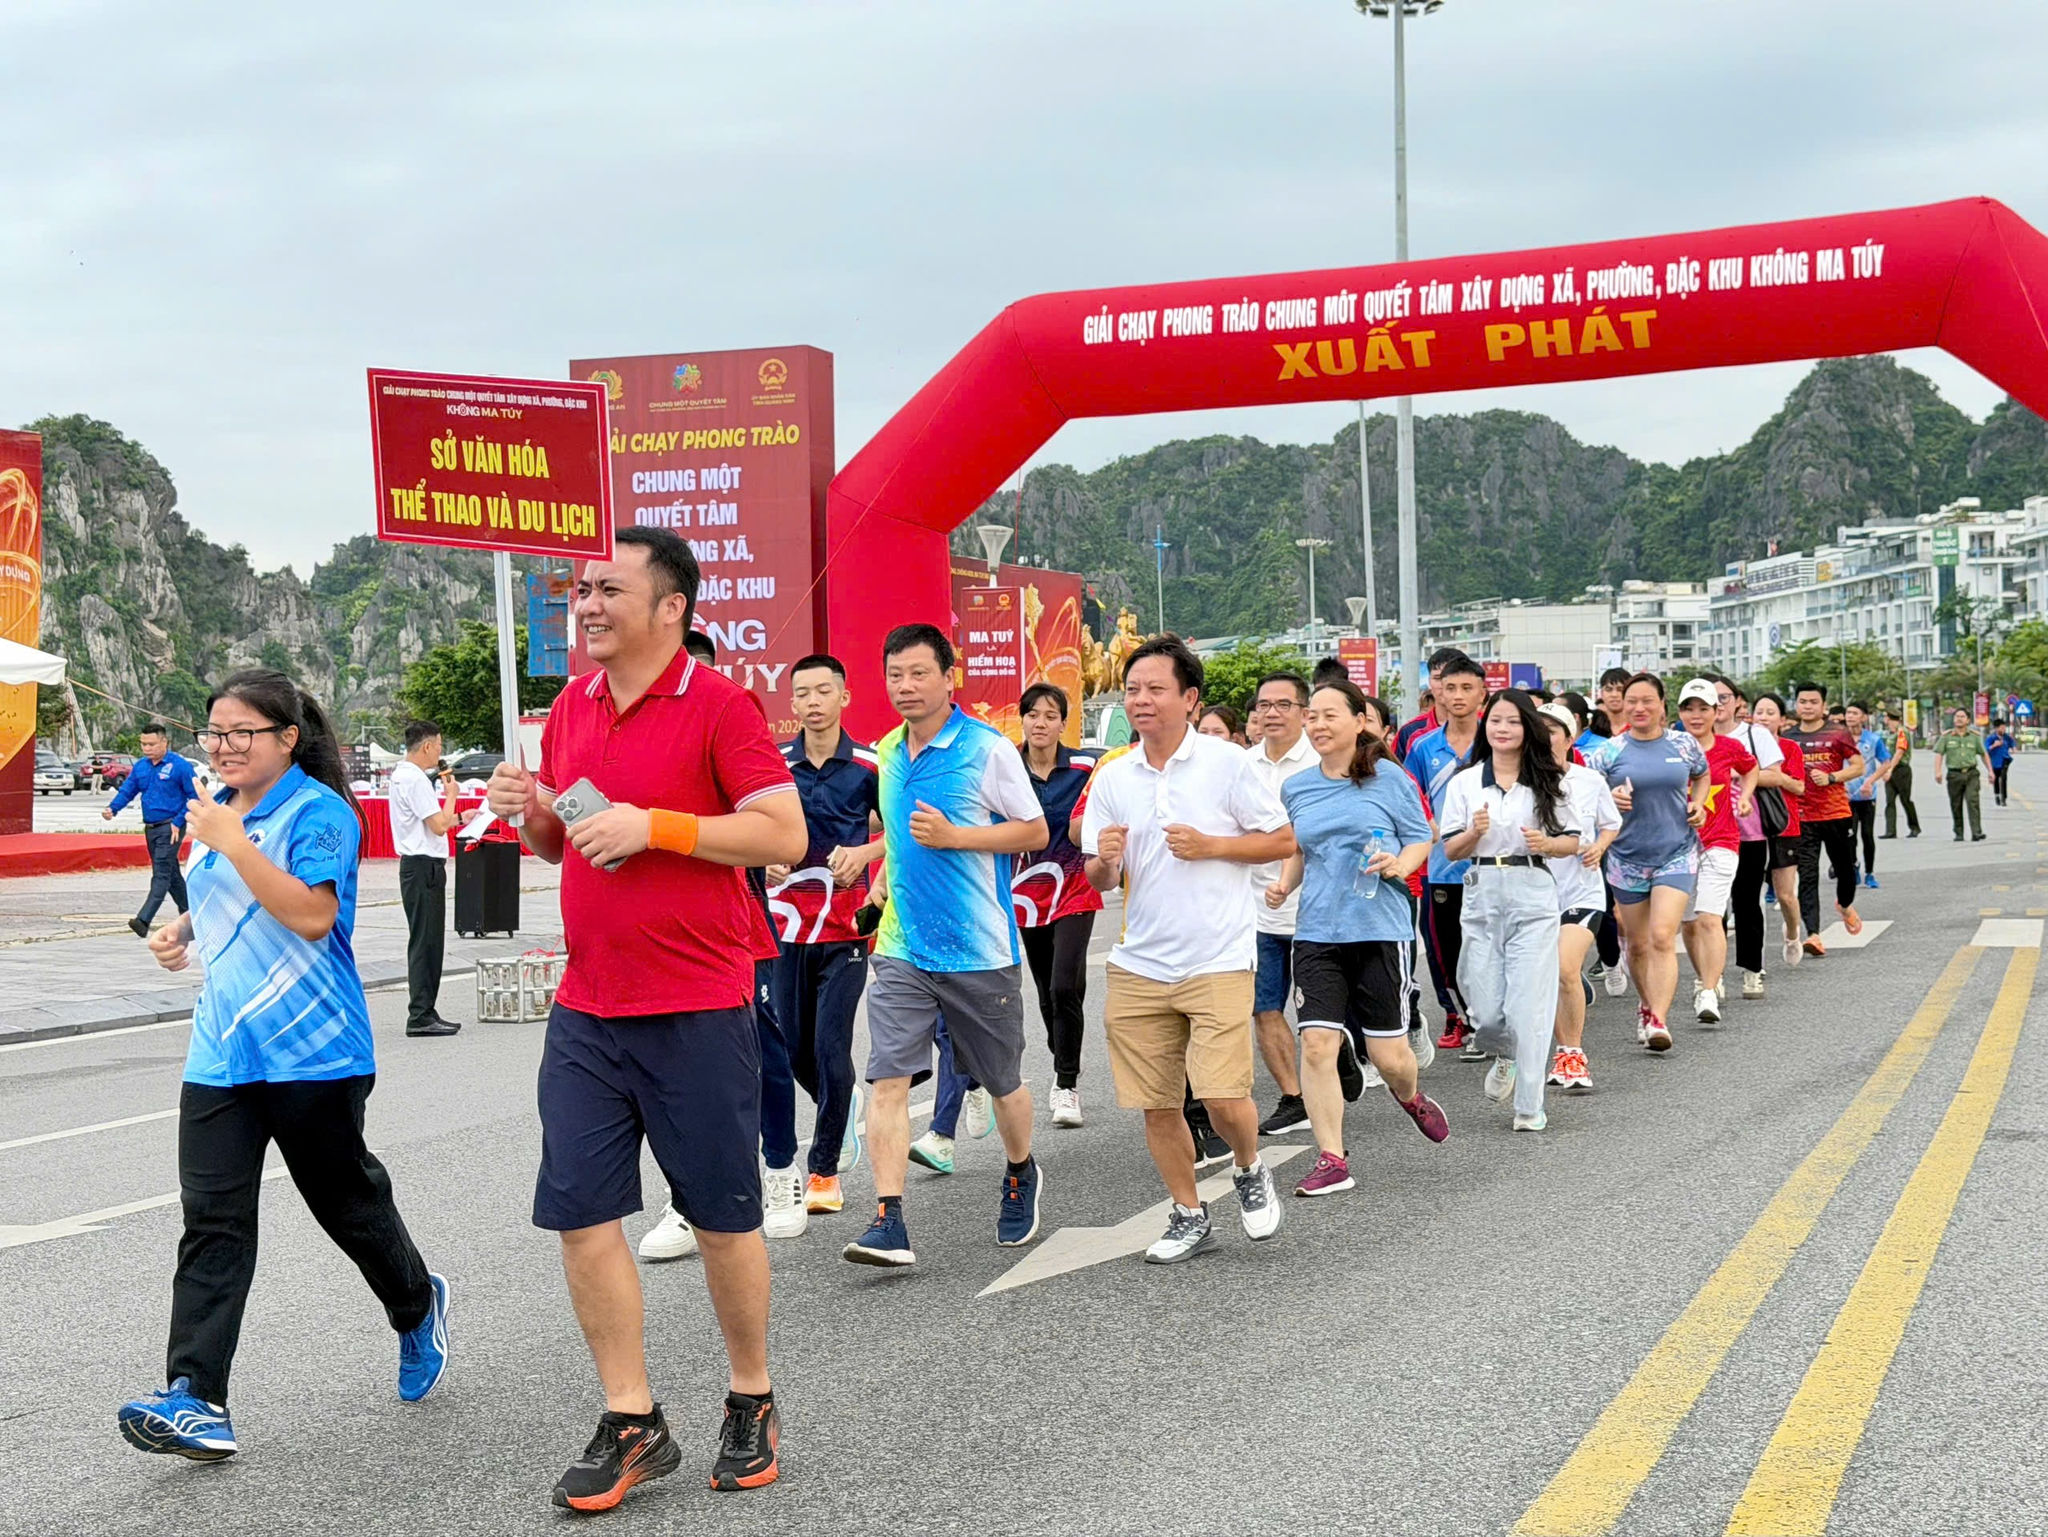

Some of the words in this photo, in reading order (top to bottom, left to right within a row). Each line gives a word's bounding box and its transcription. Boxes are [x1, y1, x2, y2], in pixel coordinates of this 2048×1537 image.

[1083, 305, 1113, 345] GIẢI
[1118, 310, 1157, 346] CHẠY
[1163, 305, 1212, 337] PHONG
[1222, 297, 1259, 333] TRÀO
[1265, 298, 1317, 331] CHUNG
[1363, 279, 1412, 325] QUYẾT
[1419, 279, 1453, 315] TÂM
[1460, 274, 1493, 312] XÂY
[1500, 272, 1545, 313] DỰNG
[1552, 267, 1582, 306] XÃ,
[1586, 260, 1661, 300] PHƯỜNG,
[1665, 256, 1700, 300] ĐẶC
[1708, 256, 1743, 291] KHU
[1750, 247, 1808, 287] KHÔNG
[1816, 248, 1845, 282] MA
[1851, 238, 1885, 278] TÚY
[1272, 320, 1436, 381] XUẤT
[1484, 305, 1658, 362] PHÁT
[446, 403, 480, 417] KHÔNG
[481, 407, 499, 418] MA
[500, 407, 522, 420] TÚY
[430, 428, 457, 470] SỞ
[462, 435, 503, 474] VĂN
[508, 438, 549, 478] HÓA
[630, 432, 679, 456] CHẠY
[682, 428, 747, 450] PHONG
[750, 419, 800, 447] TRÀO
[632, 469, 696, 494] CHUNG
[700, 462, 742, 494] MỘT
[390, 478, 427, 521] THỂ
[431, 491, 482, 526] THAO
[486, 491, 514, 529] VÀ
[518, 499, 545, 532] DU
[550, 502, 596, 542] LỊCH
[634, 498, 693, 528] QUYẾT
[696, 499, 738, 526] TÂM
[722, 534, 754, 563] XÃ,
[697, 575, 733, 605] ĐẶC
[737, 577, 775, 600] KHU
[969, 631, 989, 643] MA
[991, 628, 1014, 643] TUÝ
